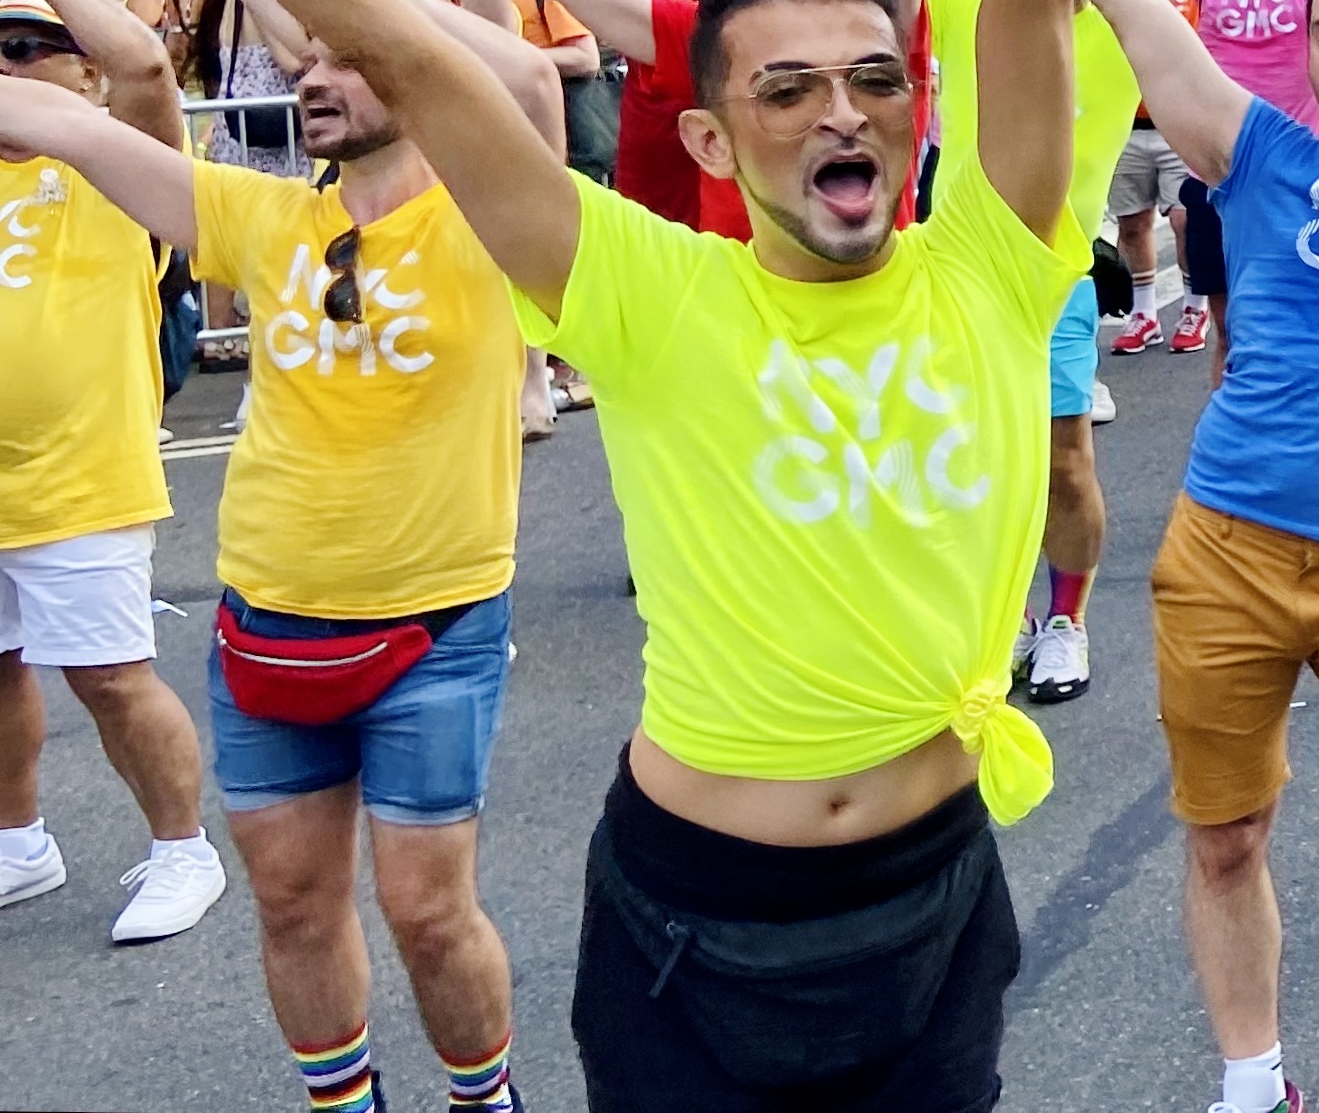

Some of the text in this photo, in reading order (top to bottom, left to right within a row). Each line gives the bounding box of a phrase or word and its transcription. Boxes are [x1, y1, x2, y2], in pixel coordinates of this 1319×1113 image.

[1216, 4, 1298, 38] GMC
[279, 243, 427, 311] NC
[264, 310, 436, 376] GMC
[757, 334, 970, 440] NYC
[752, 424, 992, 530] GMC
